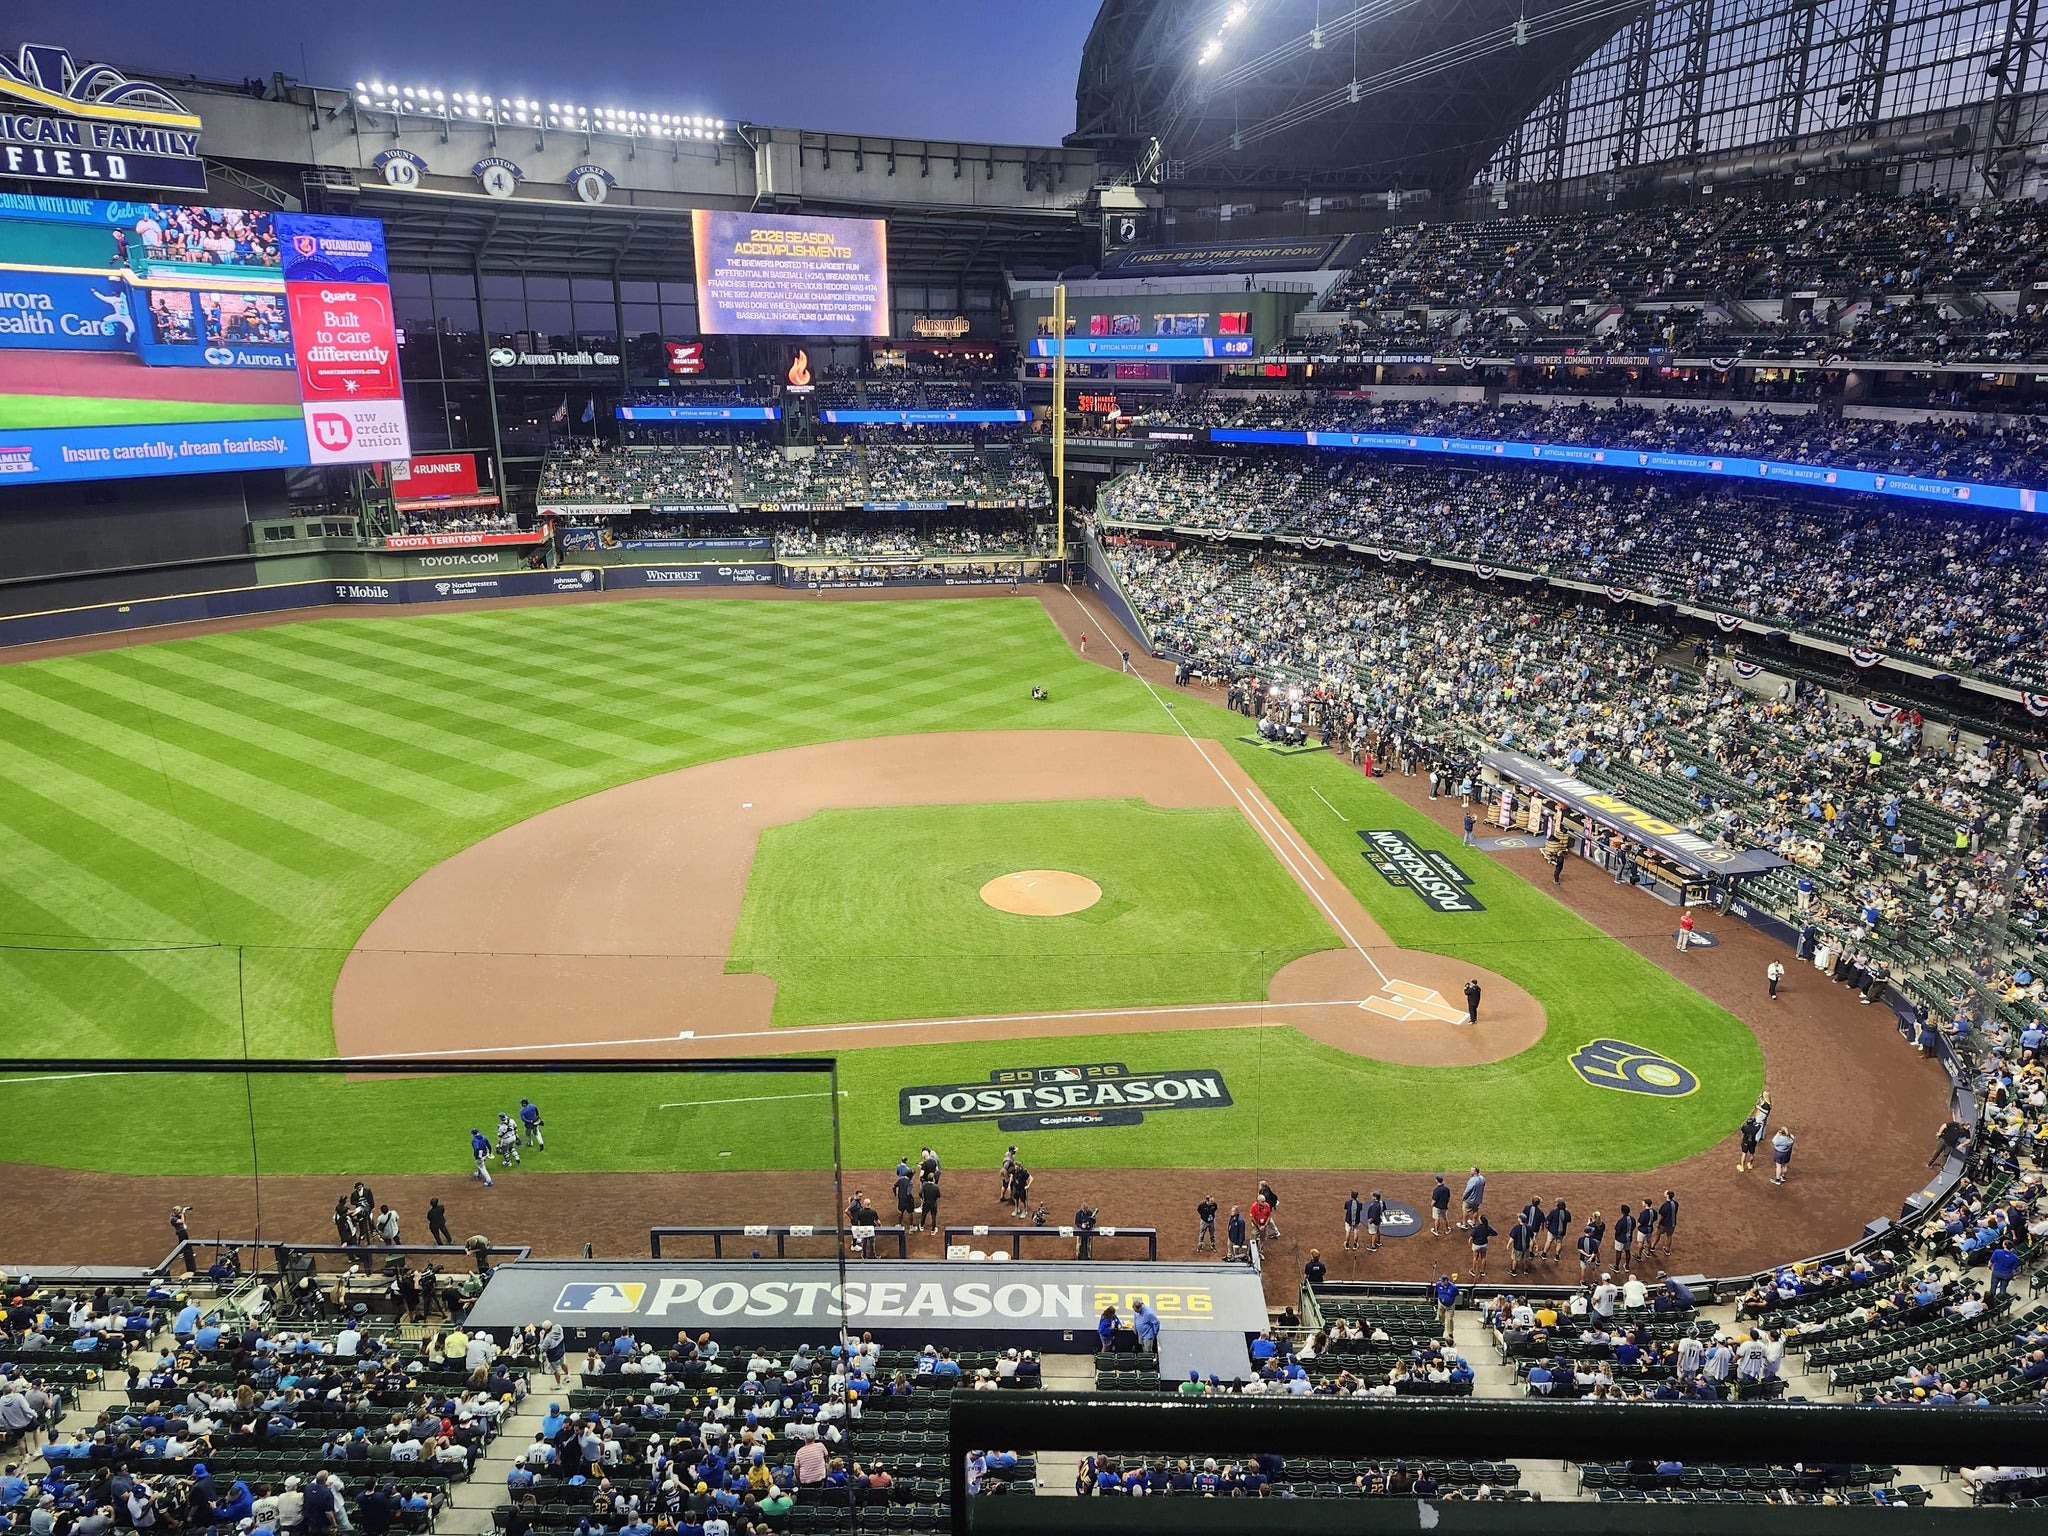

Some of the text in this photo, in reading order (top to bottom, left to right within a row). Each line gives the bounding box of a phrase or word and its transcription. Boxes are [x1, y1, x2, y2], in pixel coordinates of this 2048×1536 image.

[0, 114, 199, 157] ICAN FAMILY
[384, 150, 415, 162] YOUNT
[5, 146, 127, 180] FIELD
[478, 157, 516, 173] MOLITOR
[390, 164, 414, 184] 19
[574, 166, 606, 178] UECKER
[492, 173, 504, 192] 4
[37, 196, 65, 213] WITH
[785, 231, 835, 245] SEASON
[320, 239, 372, 252] POTAWATOMI
[734, 242, 852, 259] ACCOMPLISHMENTS
[1138, 253, 1174, 262] MUST
[1173, 252, 1190, 260] BE
[1191, 251, 1206, 259] IN
[1234, 249, 1277, 258] FRONT
[1279, 247, 1321, 256] ROW!
[742, 260, 774, 268] BREWERS
[775, 261, 802, 269] POSTED
[715, 269, 762, 278] DIFFERENTIAL
[770, 271, 804, 279] BASEBALL
[826, 273, 857, 281] BREAKING
[708, 280, 747, 288] FRANCHISE
[321, 290, 357, 304] Quartz
[770, 302, 790, 310] WHILE
[324, 312, 359, 327] Built
[736, 311, 770, 319] BASEBALL
[60, 313, 115, 336] Care
[912, 315, 970, 332] Johnsonville
[316, 331, 371, 343] to care
[236, 351, 283, 366] Aurora
[307, 346, 389, 365] differently
[518, 351, 620, 365] Aurora Health Care
[1533, 356, 1650, 365] BREWERS COMMUNITY FOUNDATION
[354, 413, 377, 423] uw
[356, 422, 400, 435] credit
[358, 435, 402, 448] union
[62, 436, 288, 463] Insure carefully, dream fearlessly.
[1544, 449, 1565, 457] OFFICIAL
[1652, 457, 1676, 465] OFFICIAL
[1677, 459, 1696, 467] WATER
[413, 463, 462, 475] 4RUNNER
[1771, 467, 1793, 477] OFFICIAL
[1795, 470, 1815, 478] WATER
[1889, 481, 1917, 491] OFFICIAL
[1918, 484, 1941, 493] WATER
[761, 503, 810, 512] 620 WTMJ
[907, 501, 943, 510] WINTRUST
[389, 534, 484, 547] TOYOTA TERRITORY
[419, 553, 499, 567] TOYOTA.COM
[646, 570, 701, 580] WINTRUST
[733, 568, 755, 576] Aurora
[451, 580, 498, 589] Northwestern
[553, 577, 578, 585] Johnson
[558, 582, 583, 590] Controls
[349, 585, 389, 599] Mobile
[452, 587, 477, 595] Mutual
[1583, 795, 1680, 834] OUR
[1368, 831, 1472, 910] POSTSEASON
[1389, 875, 1406, 885] 20
[999, 1066, 1120, 1082] 20 26
[908, 1077, 1222, 1116] POSTSEASON
[645, 1278, 1085, 1317] POSTSEASON
[1688, 1348, 1696, 1357] 11
[1749, 1351, 1761, 1359] 22
[176, 1359, 191, 1370] 32
[920, 1363, 932, 1373] 22
[534, 1454, 541, 1463] 11
[604, 1450, 611, 1460] 9
[1371, 1483, 1384, 1492] 22
[172, 1490, 186, 1509] 14
[594, 1503, 608, 1513] 32
[670, 1503, 680, 1512] 17
